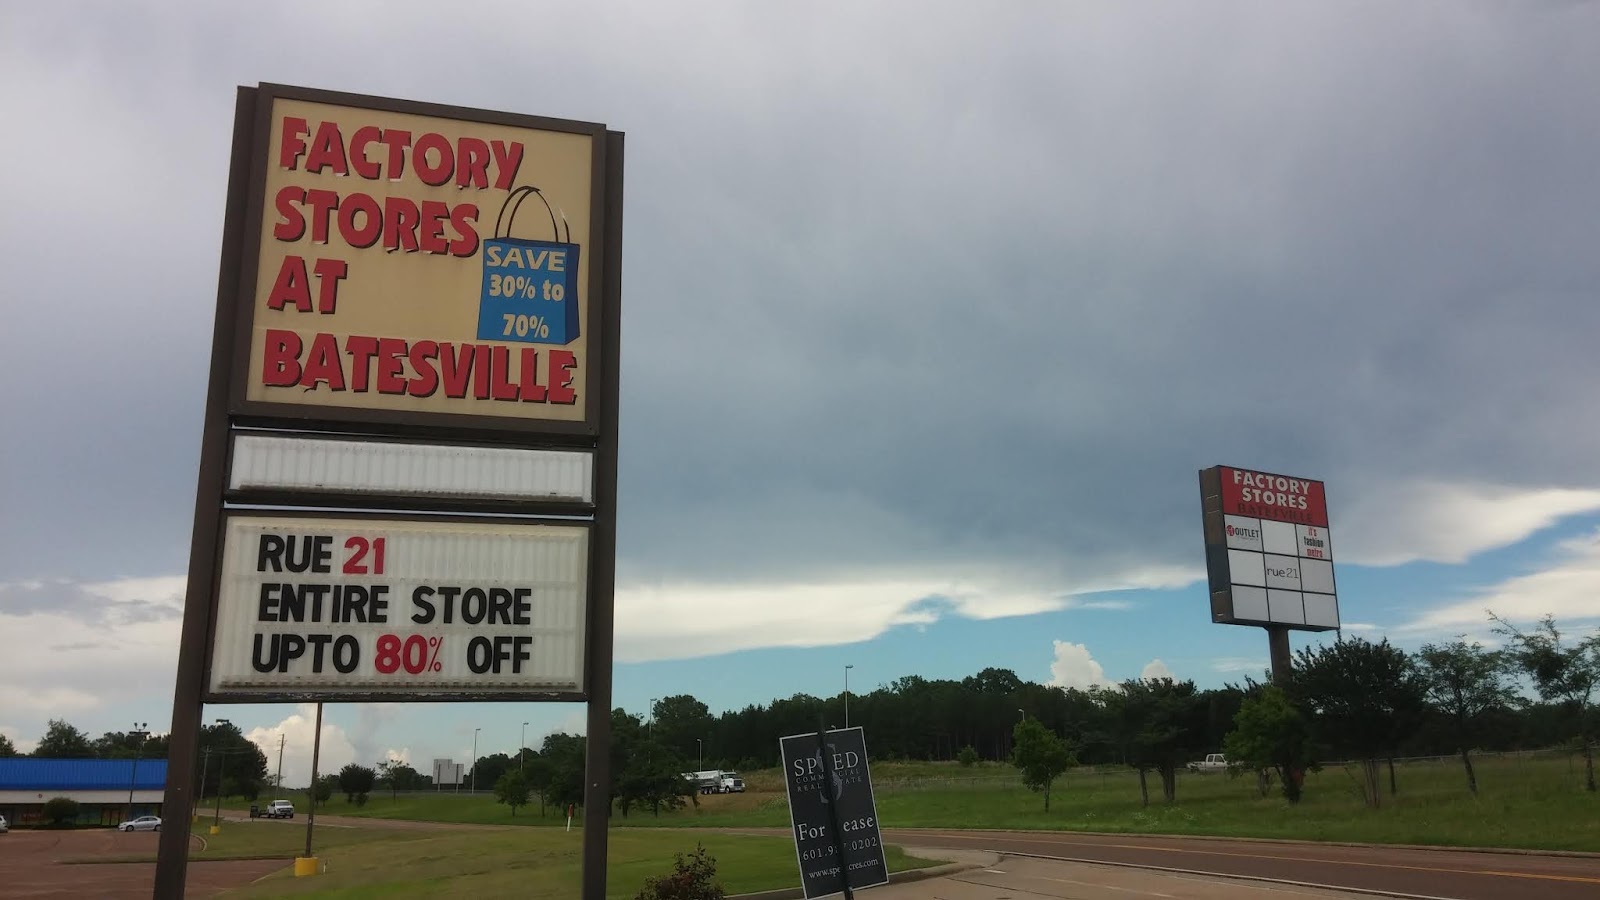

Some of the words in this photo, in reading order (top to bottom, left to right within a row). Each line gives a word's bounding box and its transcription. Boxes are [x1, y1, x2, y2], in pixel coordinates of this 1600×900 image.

[279, 116, 524, 192] FACTORY
[273, 186, 480, 258] STORES
[486, 246, 567, 272] SAVE
[266, 255, 347, 314] AT
[488, 274, 536, 300] 30%
[543, 279, 564, 302] to
[502, 313, 549, 339] 70%
[262, 329, 577, 405] BATESVILLE
[1233, 470, 1310, 495] FACTORY
[1242, 487, 1308, 510] STORES
[1235, 528, 1259, 538] OUTLET
[257, 534, 333, 573] RUE
[342, 536, 386, 575] 21
[1266, 567, 1299, 579] rue21
[258, 583, 389, 623] ENTIRE
[411, 586, 532, 625] STORE
[374, 633, 444, 675] 80%
[466, 636, 533, 674] OFF
[793, 751, 859, 777] SPED
[797, 823, 826, 841] For
[843, 816, 875, 832] ease
